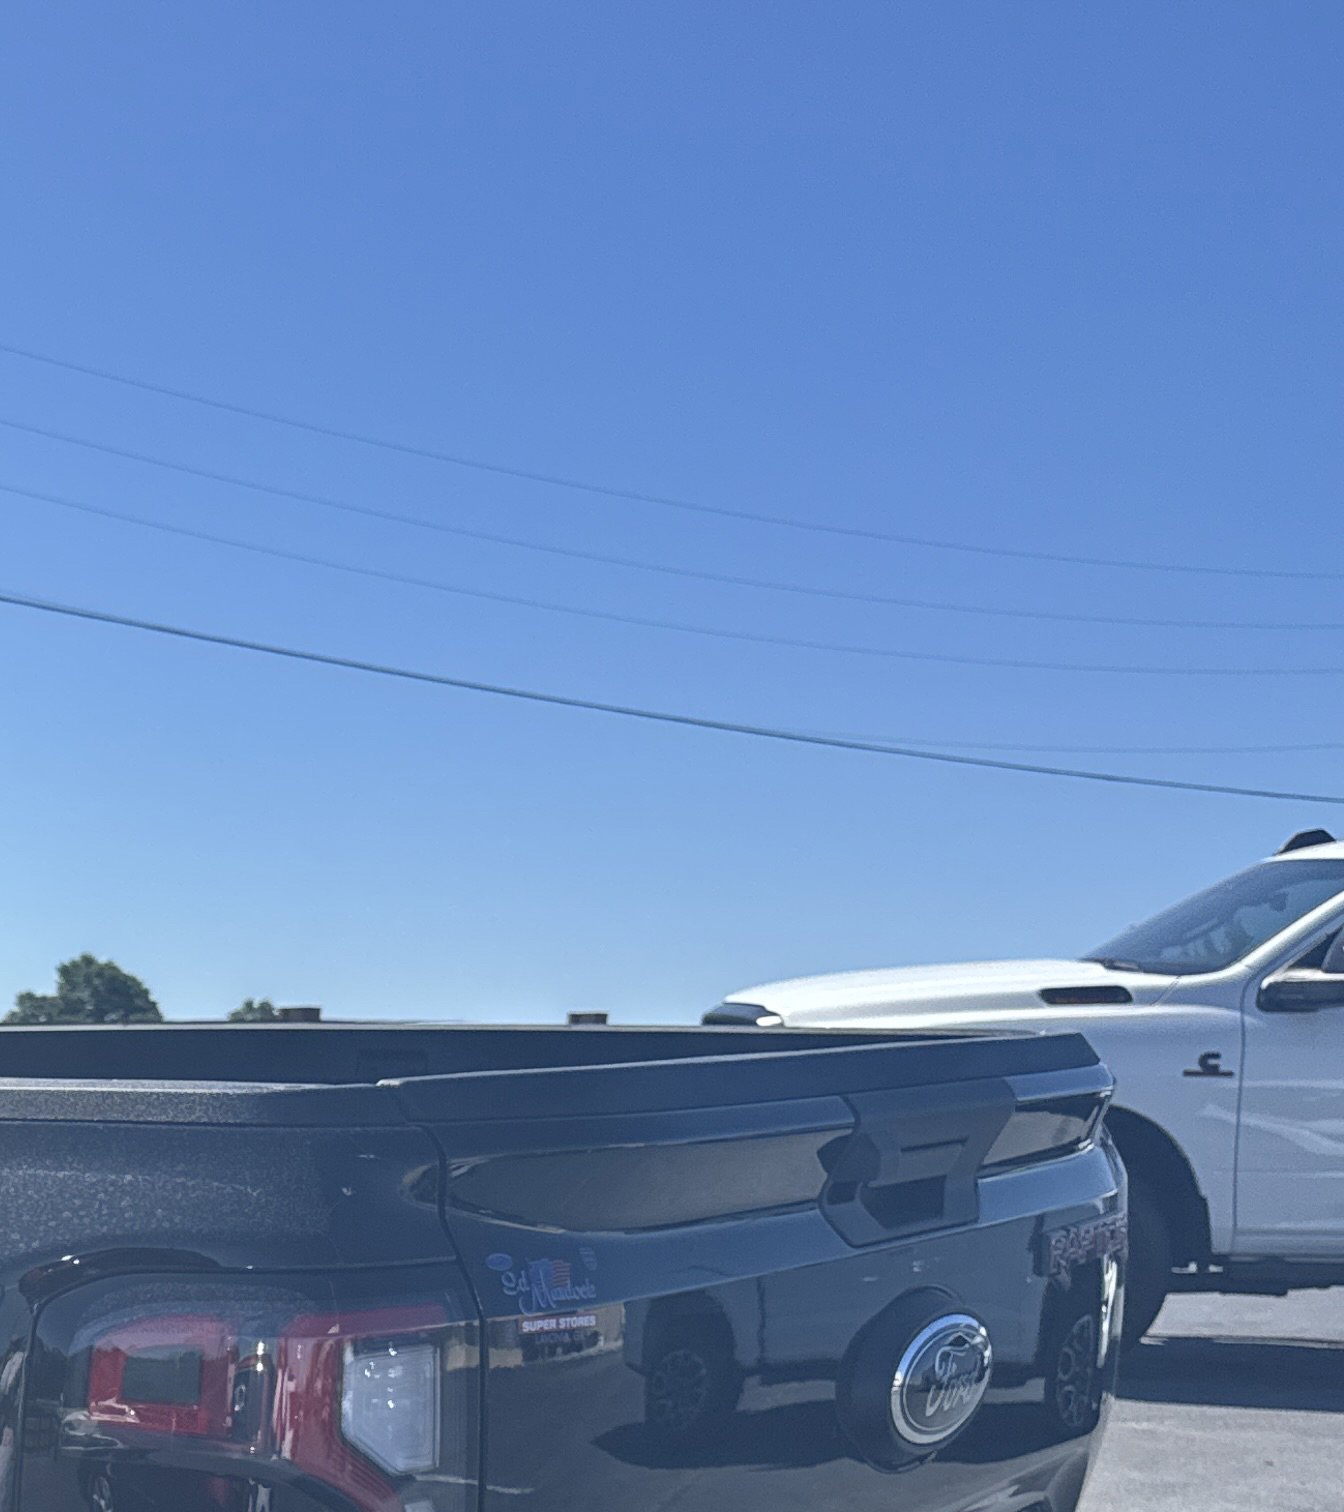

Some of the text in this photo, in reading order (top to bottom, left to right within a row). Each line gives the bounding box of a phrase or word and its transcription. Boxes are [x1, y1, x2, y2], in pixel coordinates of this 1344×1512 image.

[501, 1270, 530, 1296] Ed
[522, 1315, 597, 1333] SUPER STORES
[924, 1344, 982, 1417] Ford
